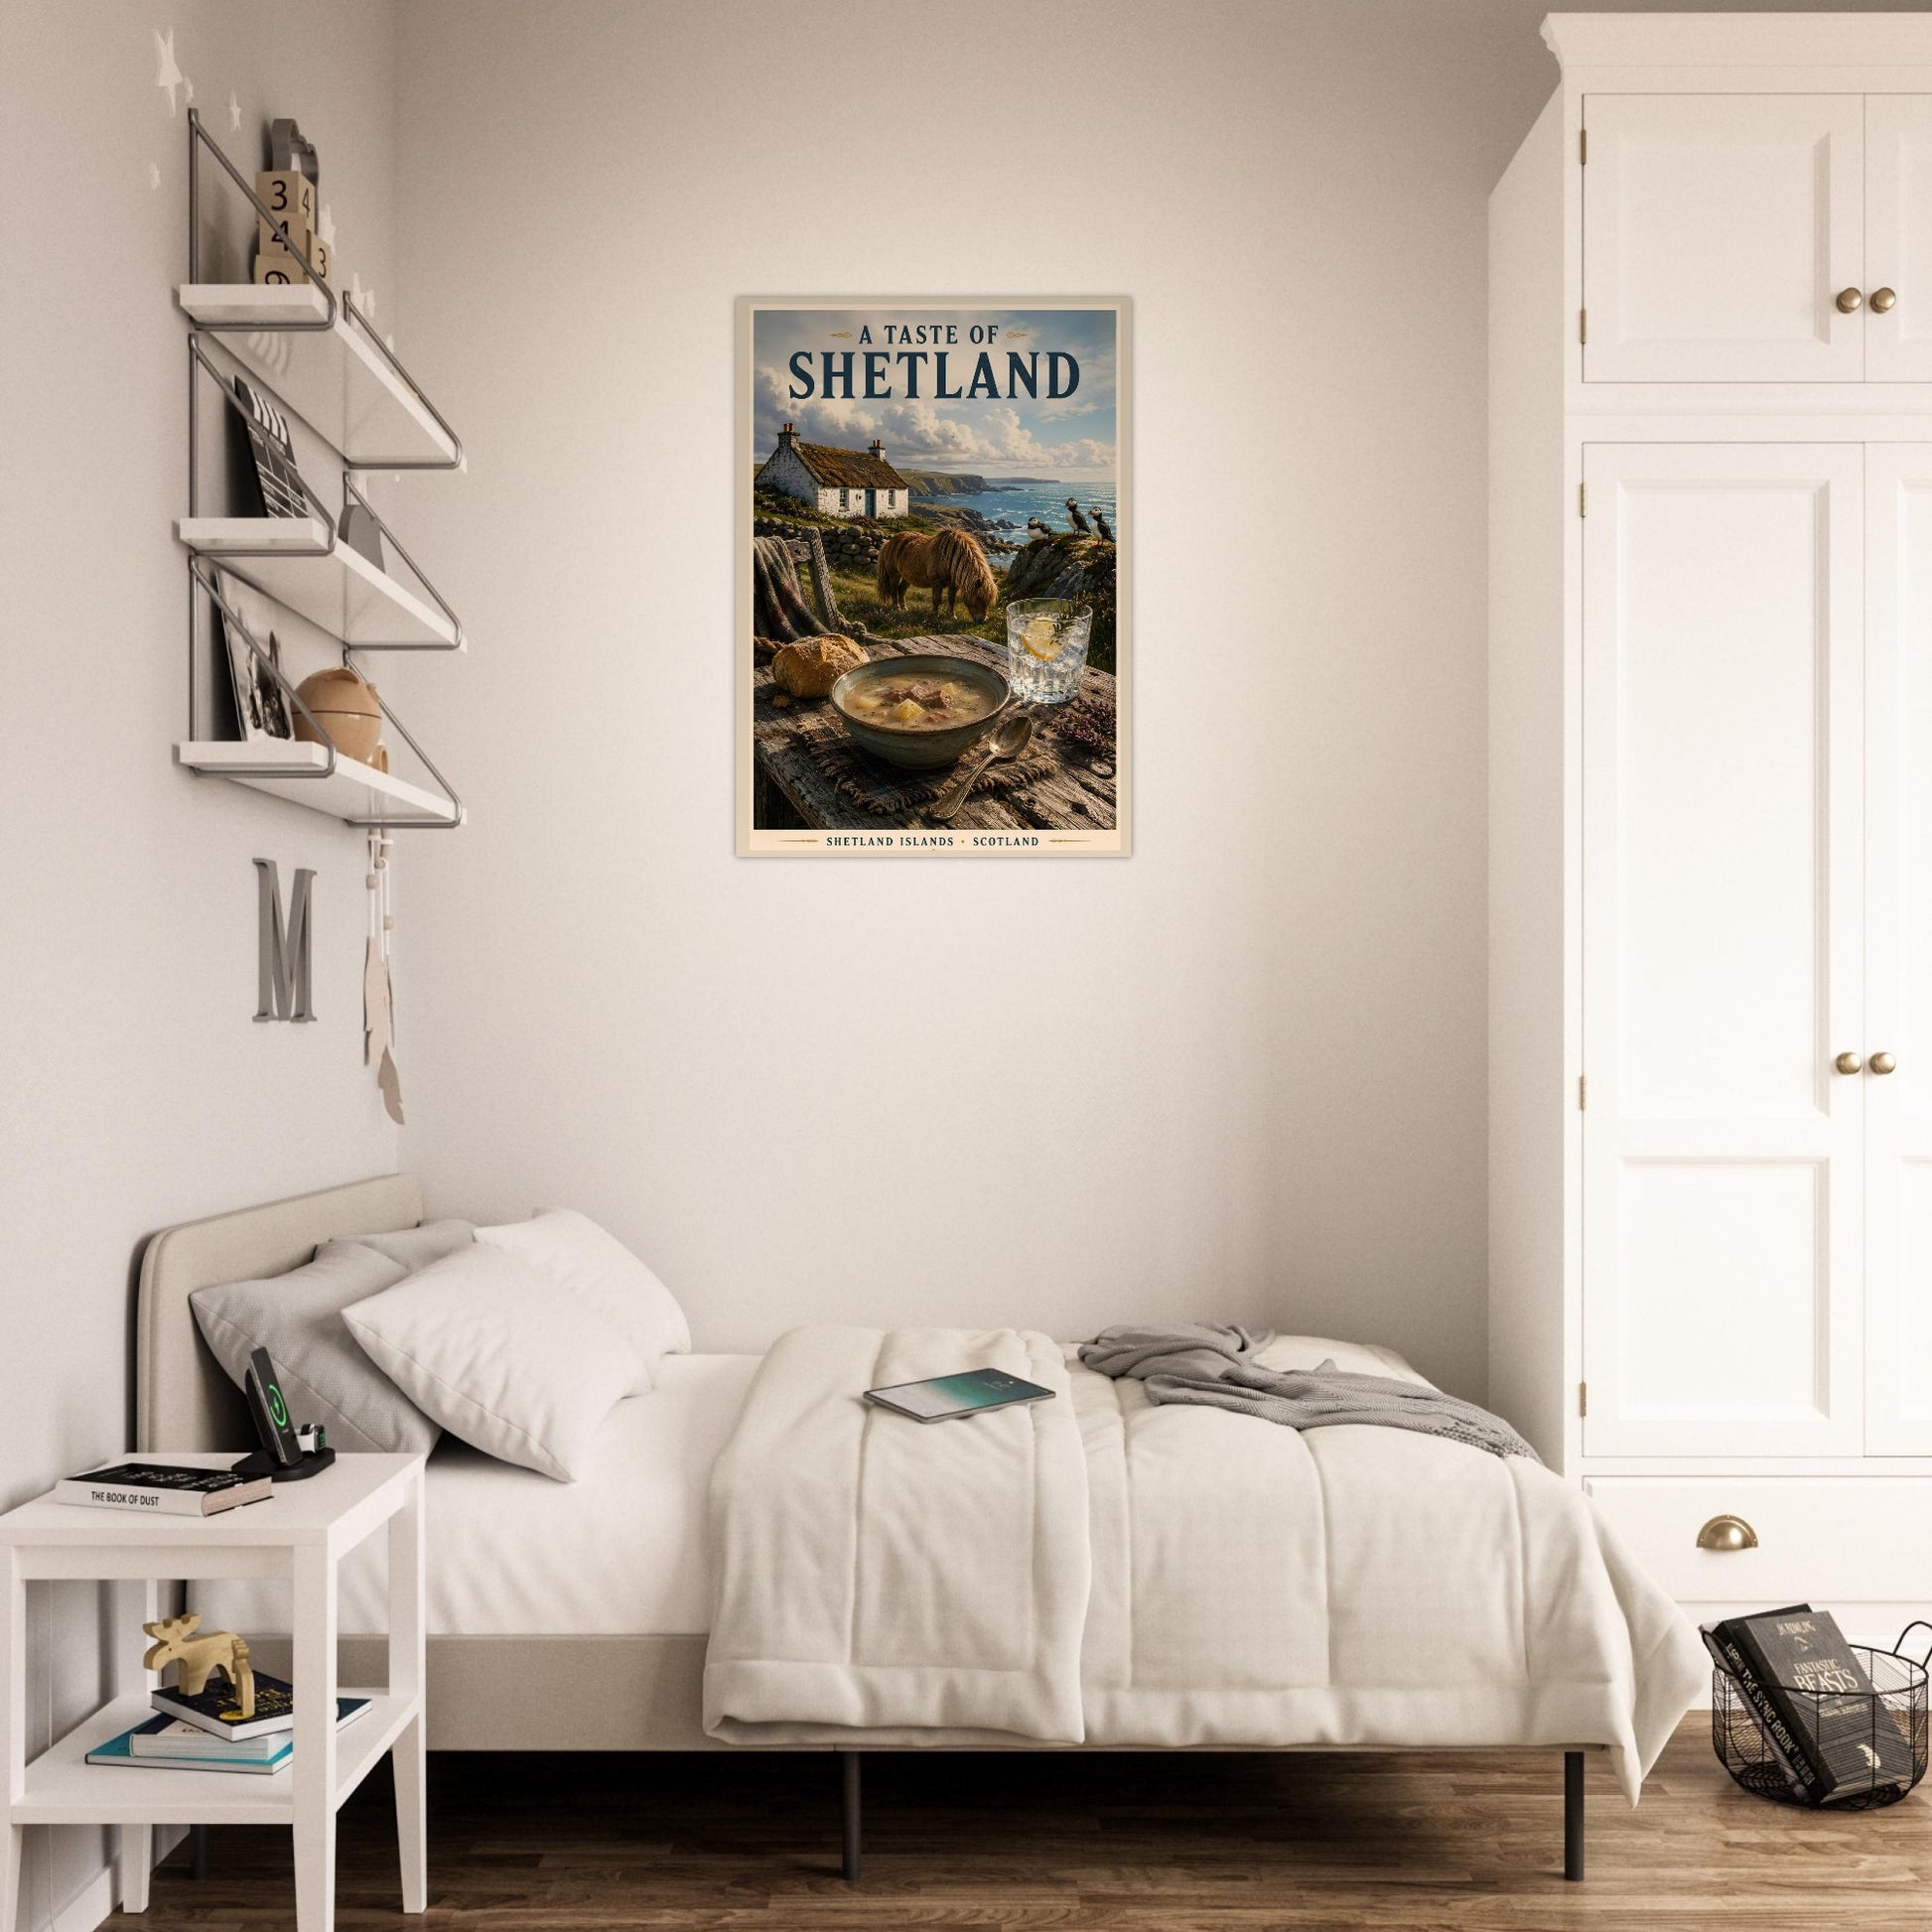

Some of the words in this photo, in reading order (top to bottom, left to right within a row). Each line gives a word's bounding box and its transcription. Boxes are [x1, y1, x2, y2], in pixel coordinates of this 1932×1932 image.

[271, 180, 288, 211] 3
[302, 189, 310, 218] 4
[271, 220, 289, 251] 4
[319, 248, 327, 278] 3
[859, 325, 873, 345] A
[884, 325, 958, 345] TASTE
[969, 325, 1000, 345] OF
[788, 350, 1080, 400] SHETLAND
[826, 836, 894, 847] SHETLAND
[899, 836, 954, 847] ISLANDS
[973, 836, 1039, 847] SCOTLAND
[252, 858, 318, 1023] M
[91, 1491, 105, 1502] THE
[106, 1492, 127, 1503] BOOK
[128, 1494, 139, 1504] OF
[140, 1495, 159, 1506] DUST
[1793, 1669, 1859, 1694] BEASTS
[1794, 1659, 1842, 1675] FANTASTIC
